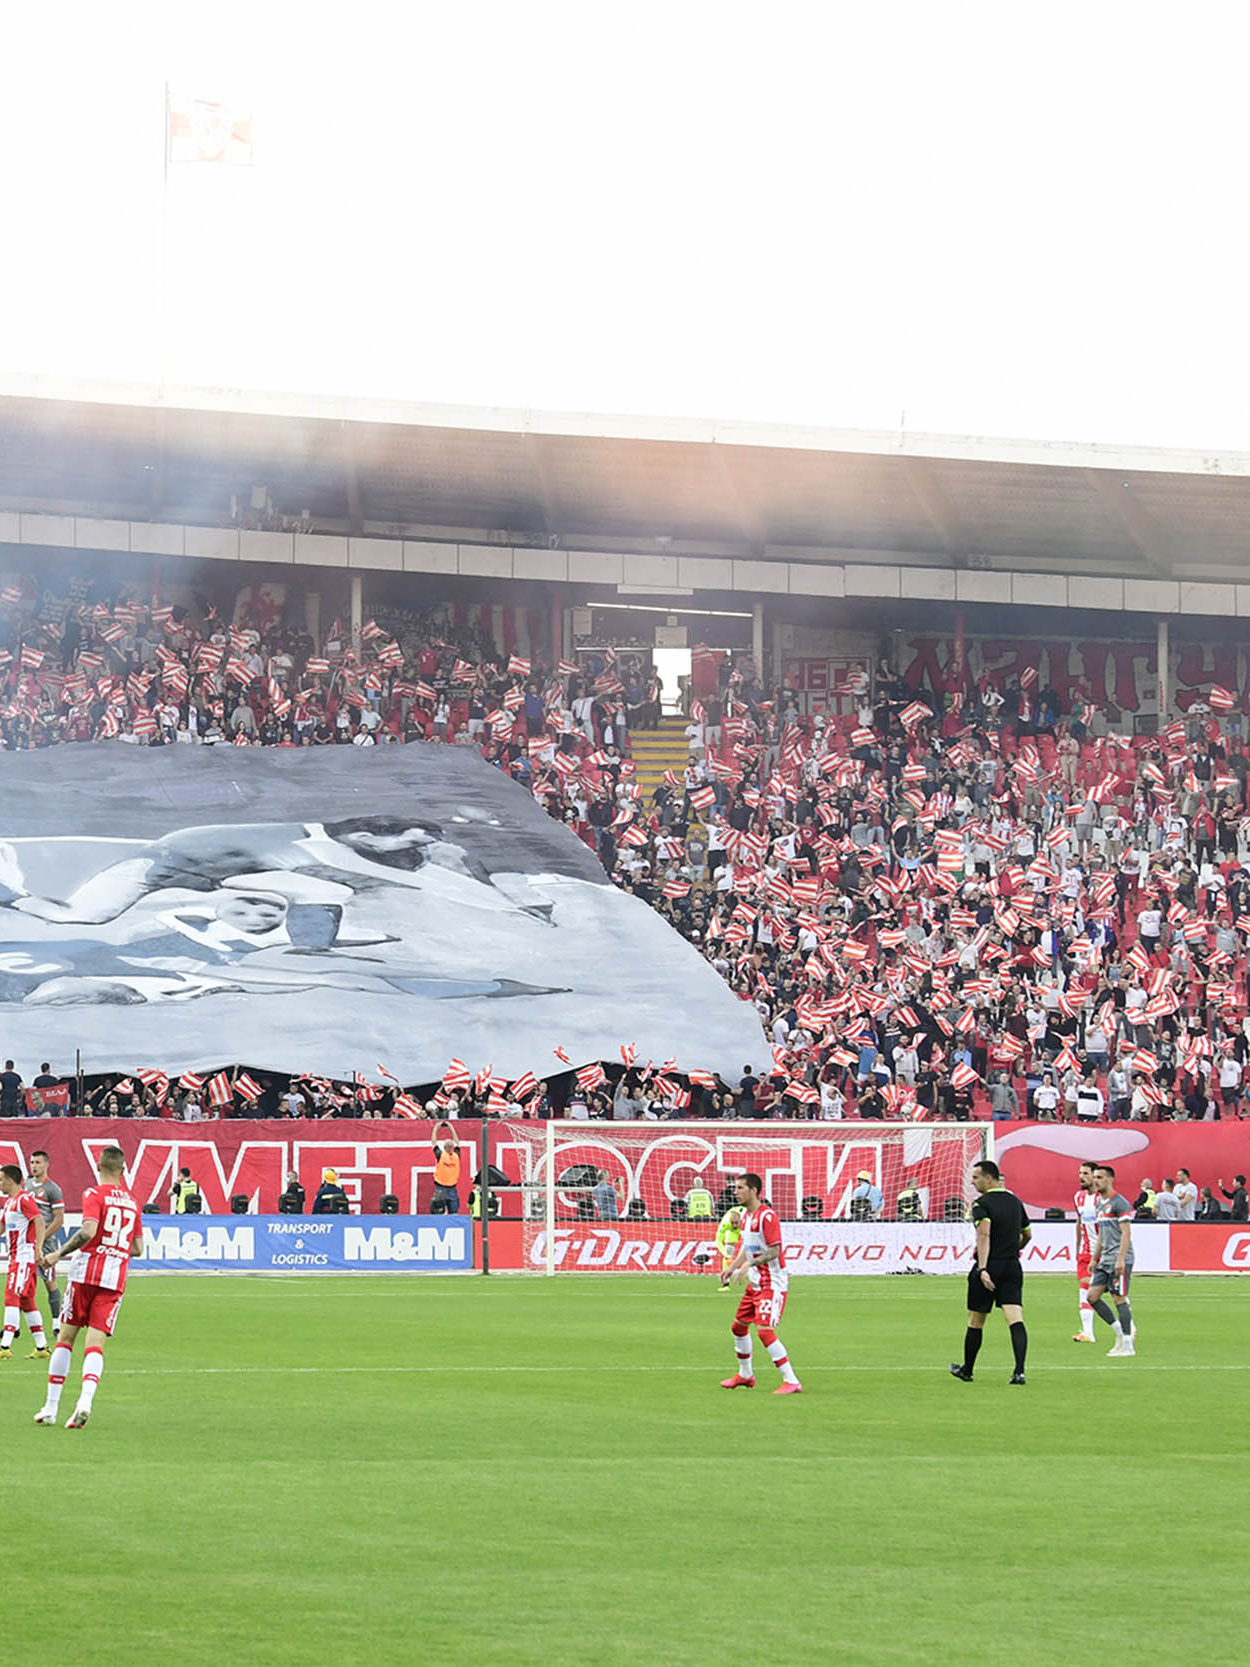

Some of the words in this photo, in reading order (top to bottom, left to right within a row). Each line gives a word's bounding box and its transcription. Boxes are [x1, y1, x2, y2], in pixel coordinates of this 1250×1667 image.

[101, 1206, 137, 1250] 92
[267, 1223, 334, 1234] TRANSPORT
[141, 1226, 255, 1261] M&M
[295, 1239, 305, 1249] &
[344, 1227, 465, 1261] M&M
[271, 1254, 328, 1265] LOGISTICS
[783, 1244, 886, 1261] ORIVO
[759, 1299, 772, 1314] 22
